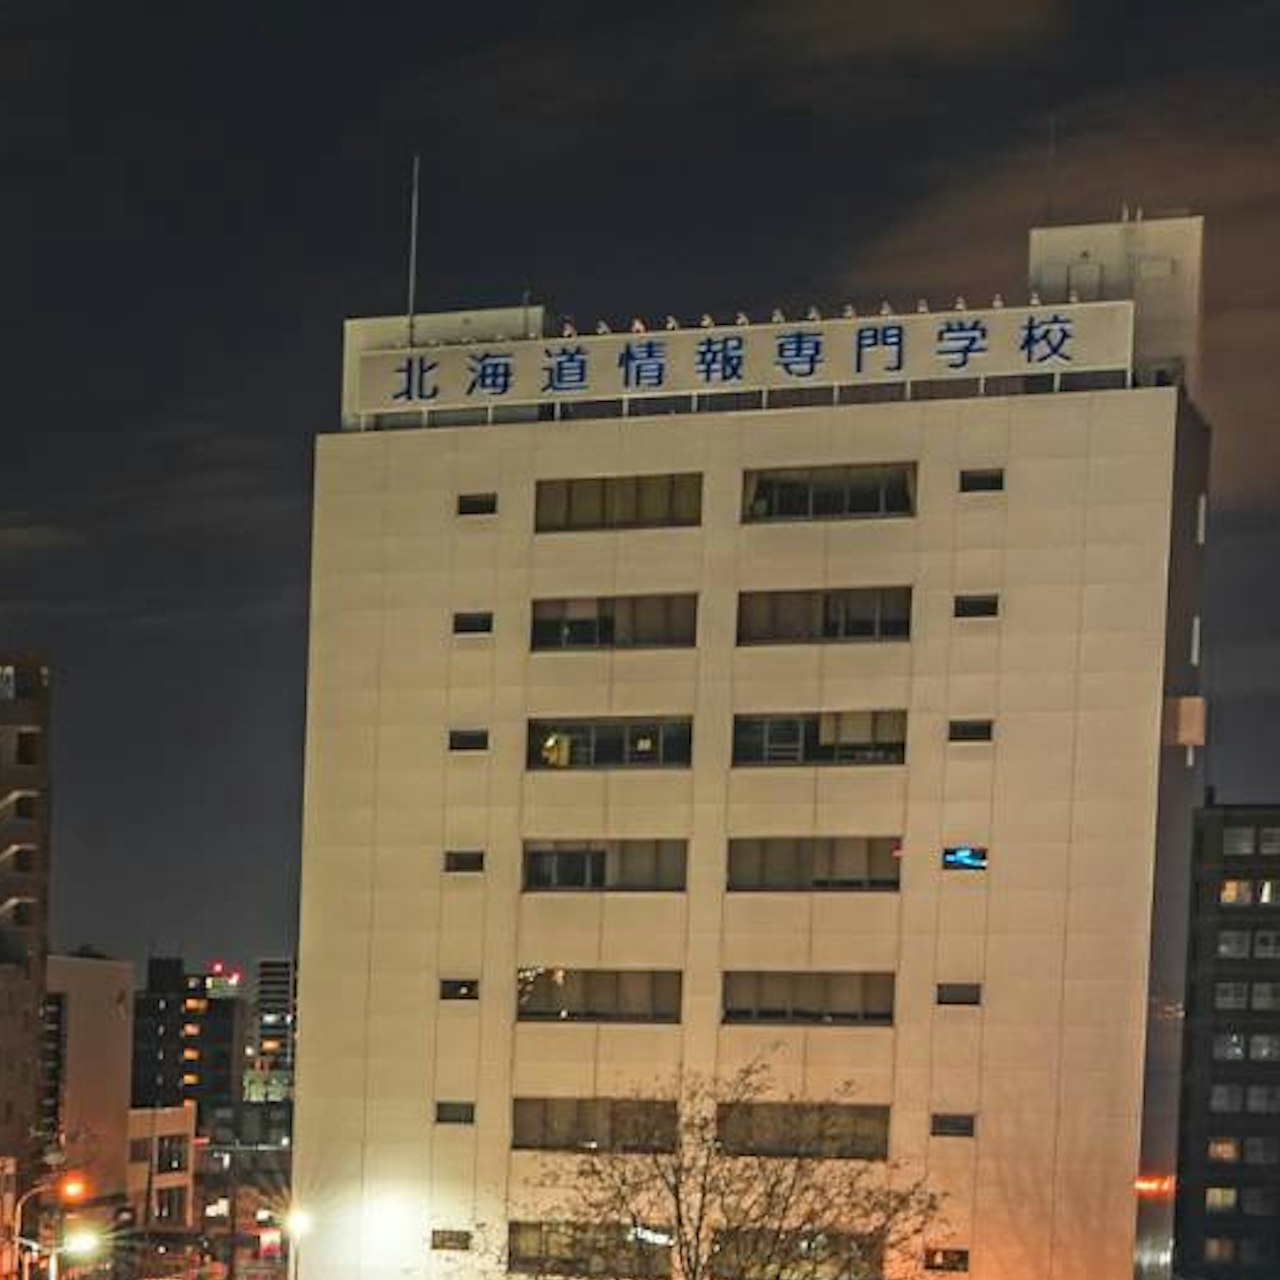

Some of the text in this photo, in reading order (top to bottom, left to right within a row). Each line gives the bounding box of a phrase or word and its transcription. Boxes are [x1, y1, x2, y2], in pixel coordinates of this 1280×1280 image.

[393, 313, 1074, 402] 北海道情報専門学校
